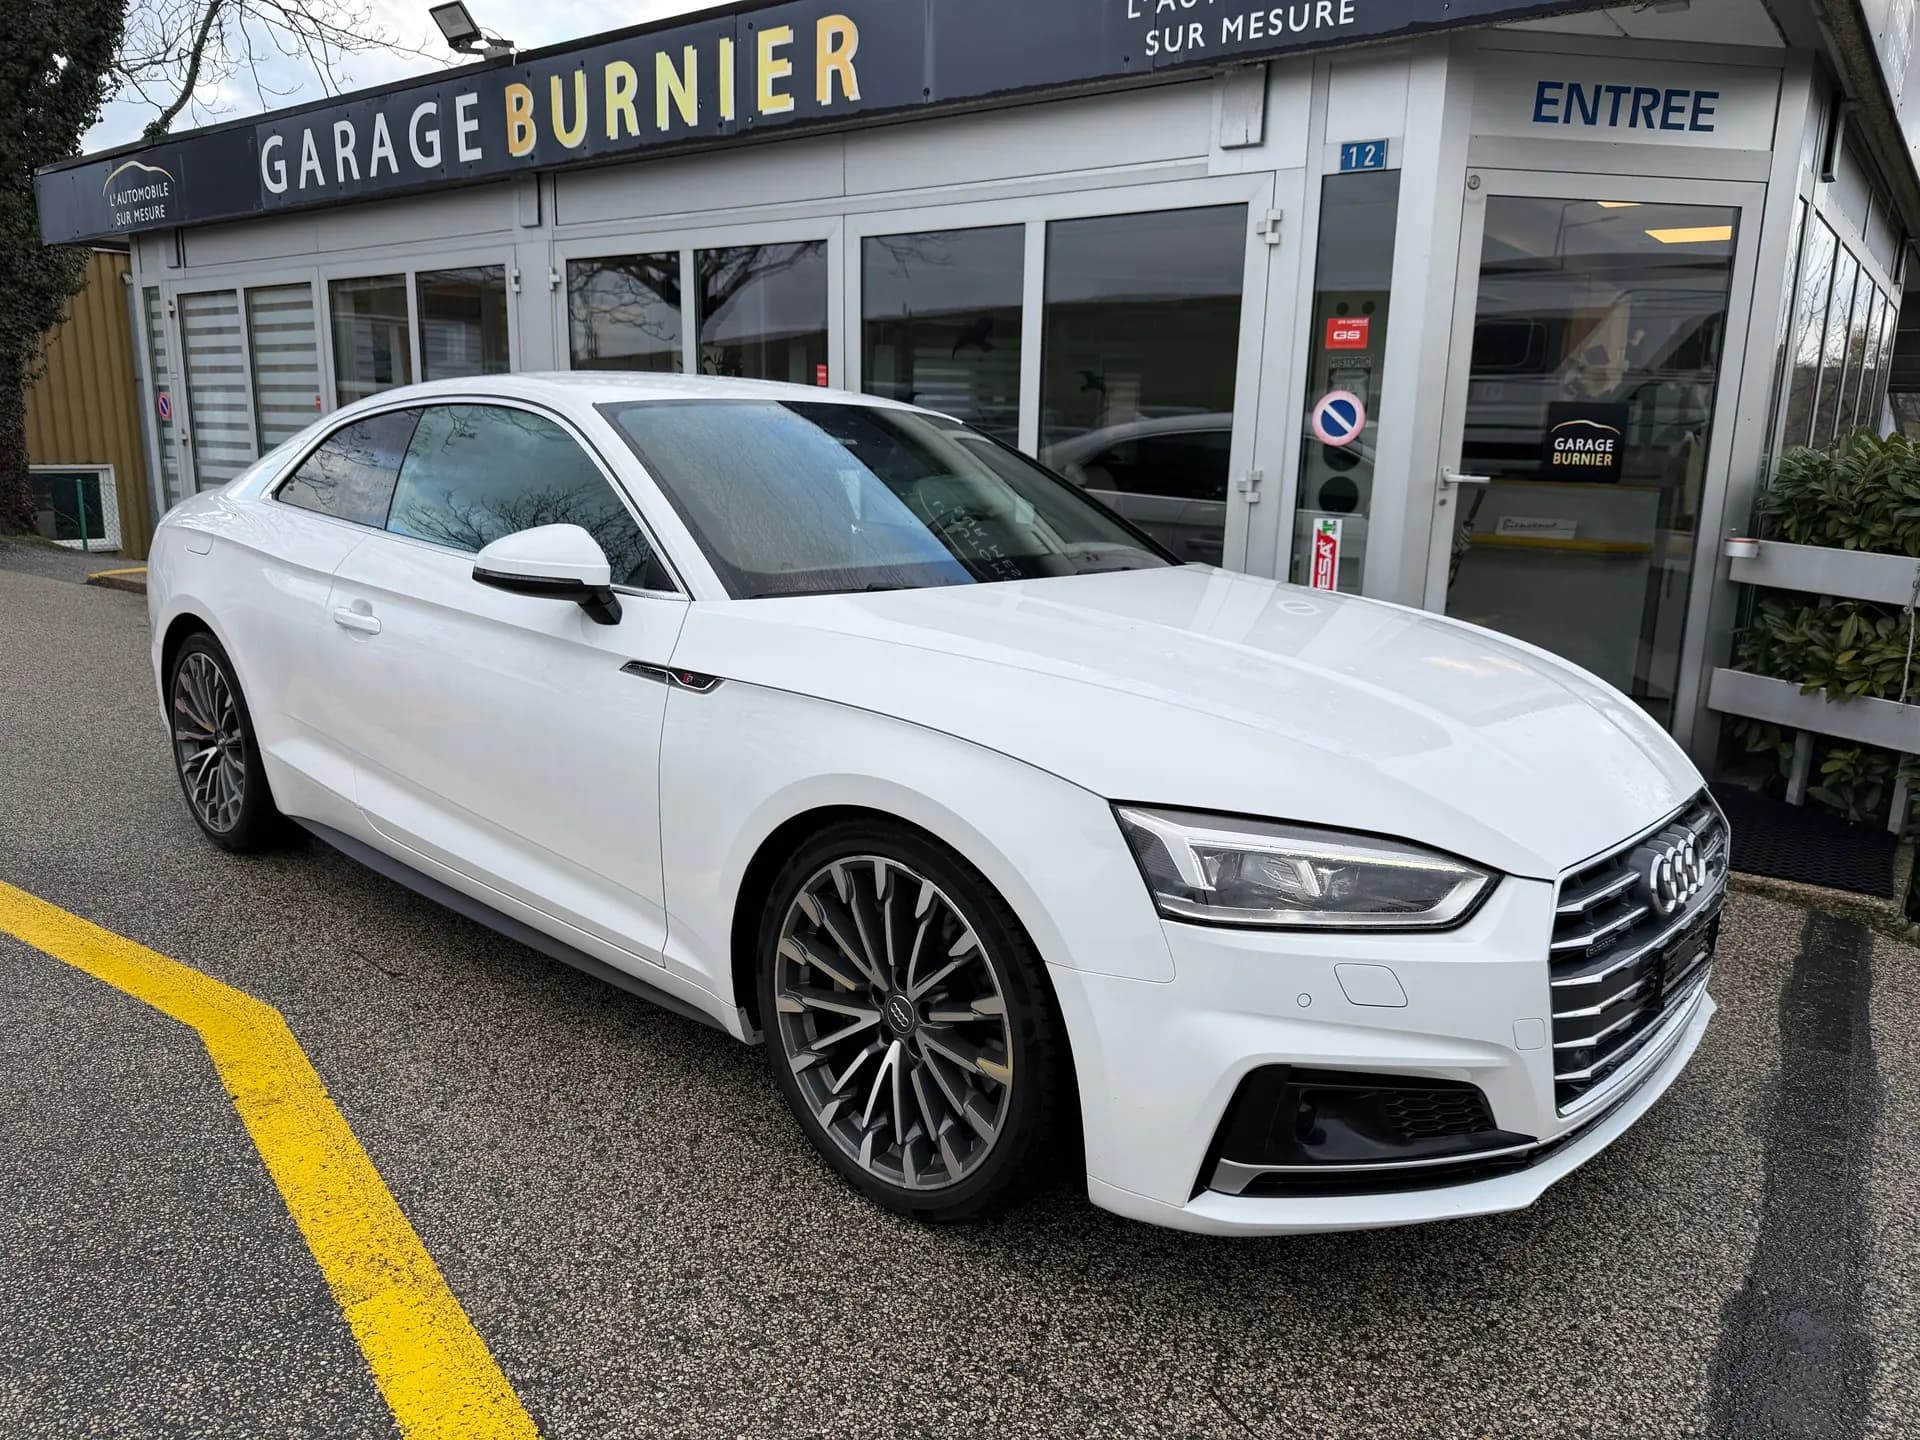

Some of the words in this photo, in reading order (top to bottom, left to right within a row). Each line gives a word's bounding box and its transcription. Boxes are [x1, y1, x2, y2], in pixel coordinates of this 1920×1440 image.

[1145, 23, 1205, 56] SUR
[1221, 0, 1355, 44] MESURE
[261, 92, 483, 194] GARAGE
[505, 14, 861, 157] BURNIER
[1532, 80, 1720, 132] ENTREE
[1349, 145, 1376, 168] 12
[110, 182, 169, 207] L'AUTOMOBILE
[116, 211, 132, 226] SUR
[133, 204, 166, 223] MESURE
[1554, 437, 1614, 452] GARAGE
[1552, 452, 1613, 466] BURNIER
